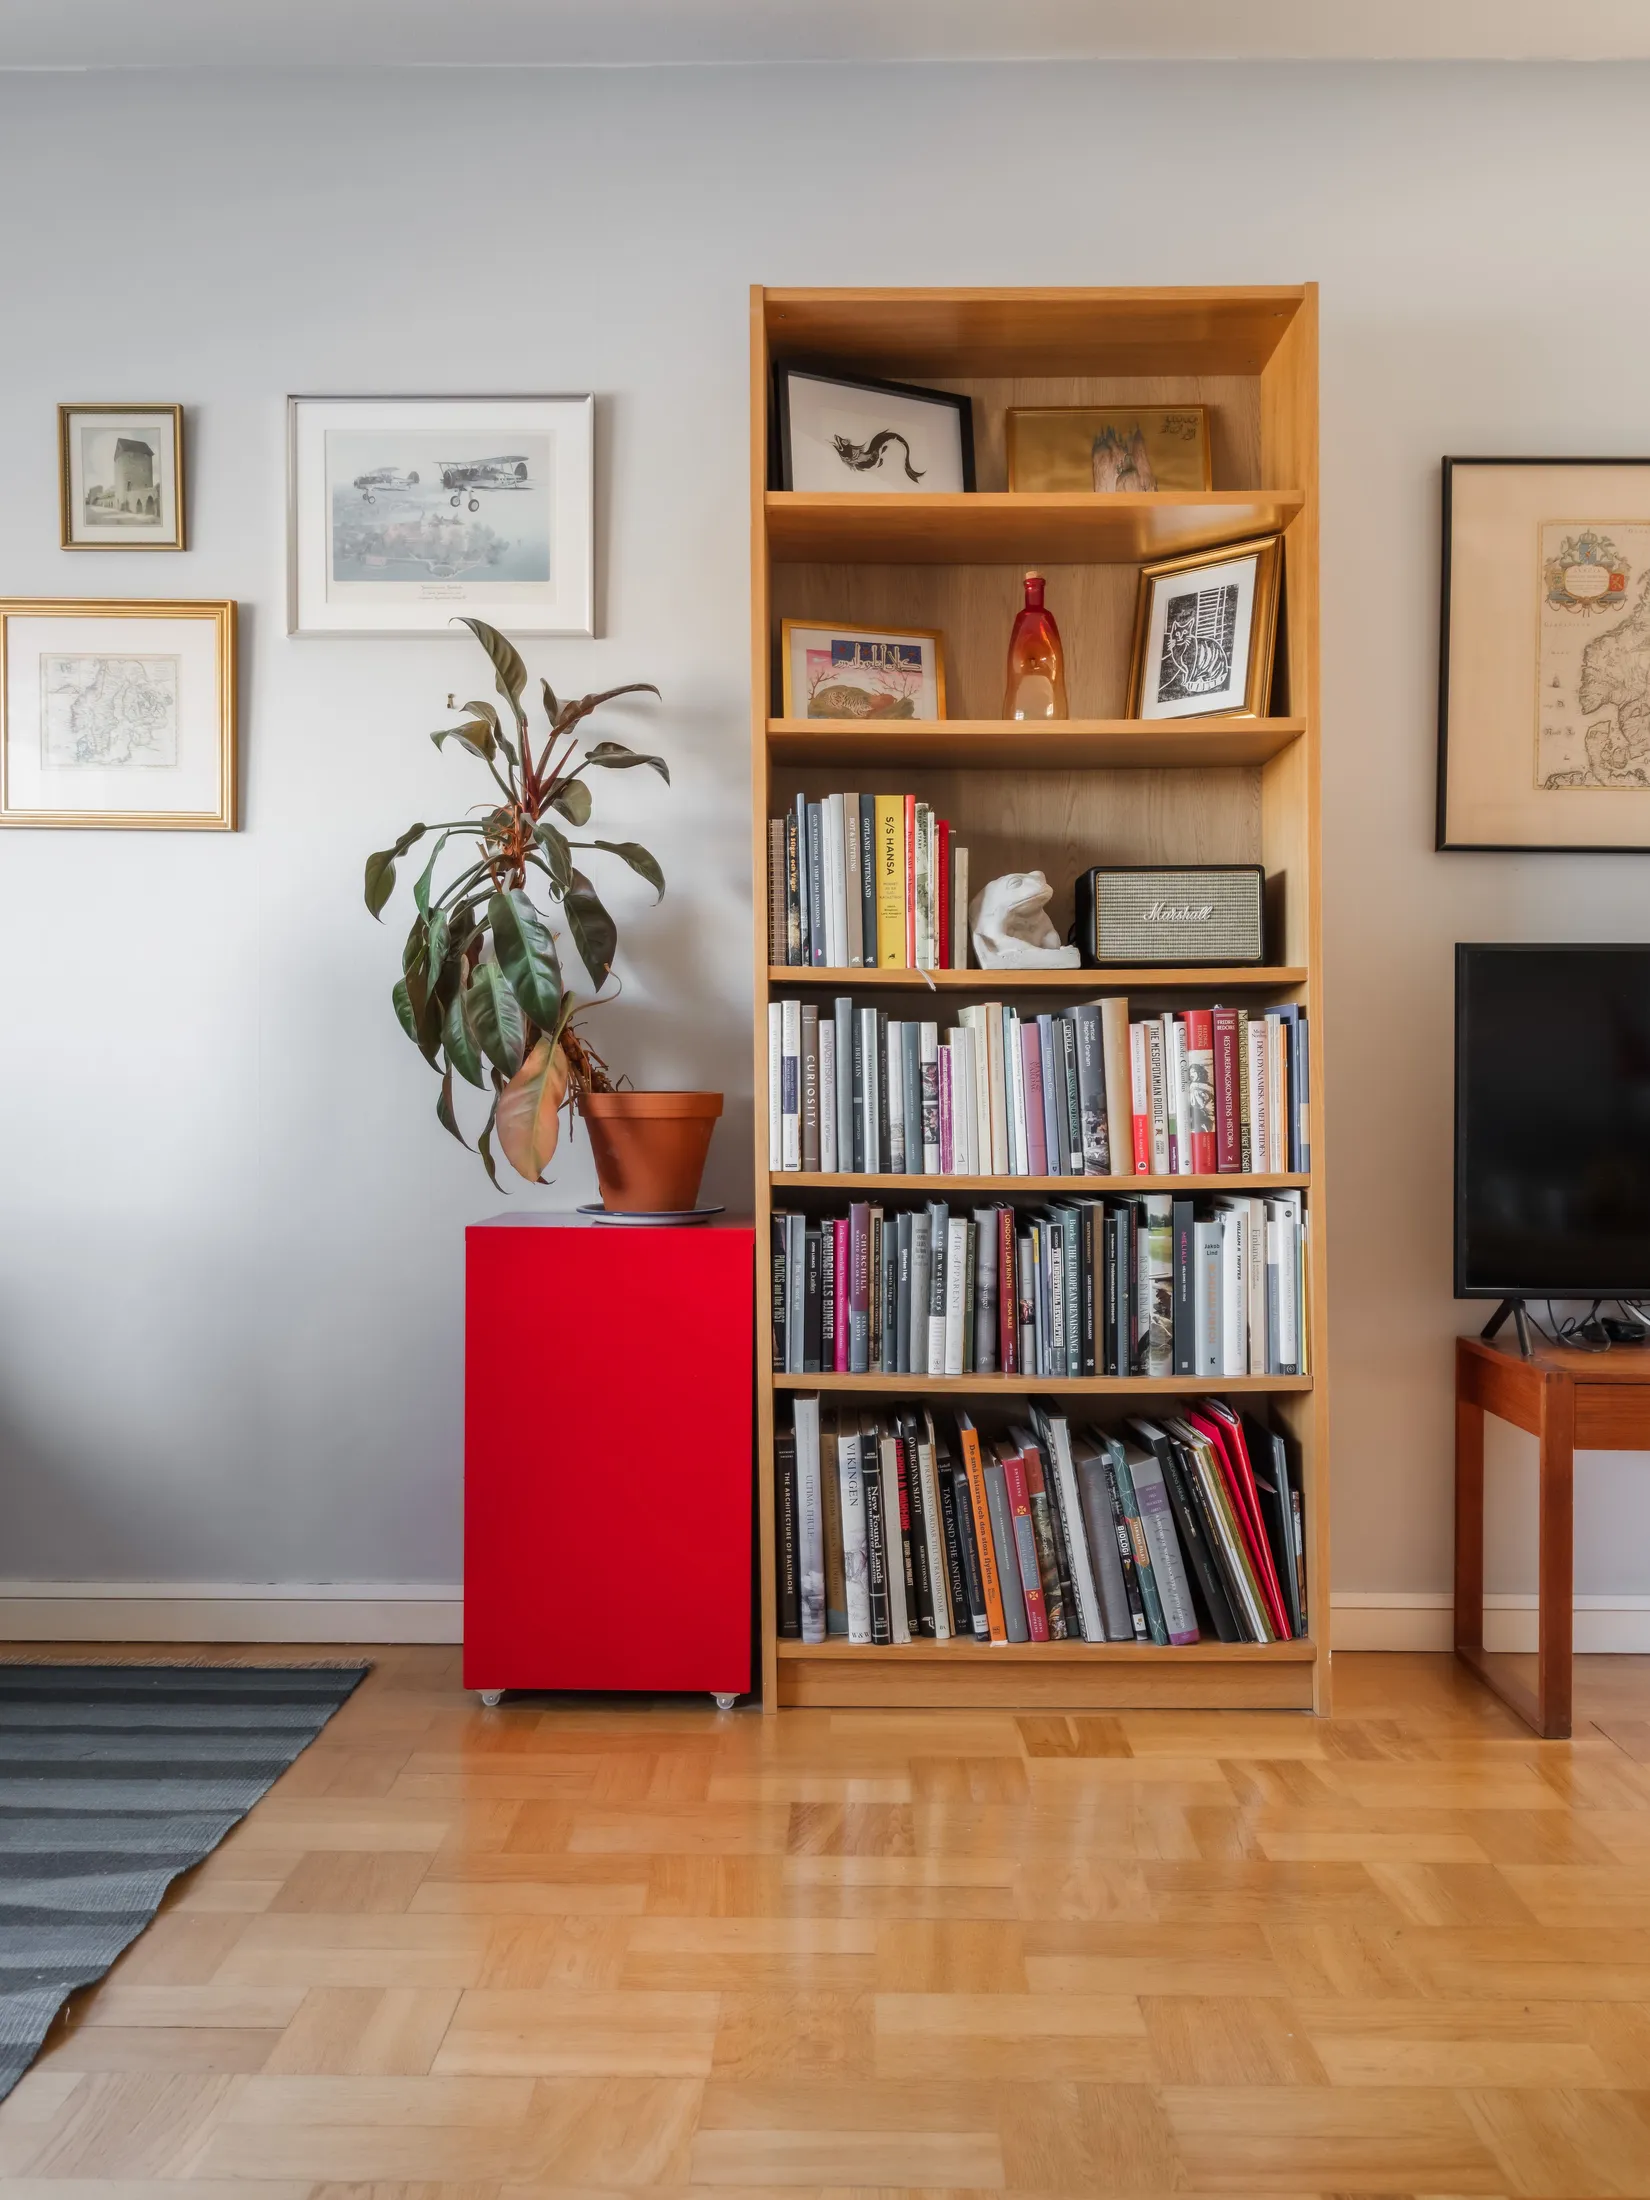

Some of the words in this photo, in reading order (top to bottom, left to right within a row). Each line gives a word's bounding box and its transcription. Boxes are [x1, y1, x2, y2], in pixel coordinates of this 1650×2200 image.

[885, 817, 894, 834] S/S
[886, 838, 894, 875] HANSA
[1143, 901, 1214, 921] Marshall
[1065, 1025, 1073, 1053] CIPOLLA
[1150, 1027, 1159, 1040] THE
[1240, 1012, 1248, 1058] Medeltidens
[824, 1041, 833, 1085] NAZISTISKA
[1151, 1043, 1161, 1096] MESOPOTAMIAN
[1224, 1036, 1233, 1117] RESTAURERINGSKONSTENS
[1240, 1059, 1249, 1094] allmänna
[807, 1055, 815, 1127] CURIOSITY
[1153, 1098, 1163, 1124] RIDDLE
[1241, 1095, 1250, 1122] historia
[1242, 1126, 1250, 1147] Jerker
[1243, 1149, 1251, 1172] Rosén
[953, 1230, 961, 1250] AIR
[1004, 1214, 1012, 1250] LONDON'S
[1252, 1229, 1261, 1263] Finland
[822, 1235, 833, 1296] CHURCHILLS
[1052, 1248, 1060, 1262] THE
[1068, 1245, 1076, 1260] THE
[774, 1255, 785, 1282] POLITICS
[953, 1255, 961, 1310] APPARENT
[1069, 1262, 1077, 1302] EUROPEAN
[774, 1285, 784, 1294] and
[1053, 1264, 1061, 1303] INDUSTRIAL
[774, 1296, 784, 1305] the
[1139, 1293, 1149, 1324] FINLAND
[774, 1307, 784, 1323] PAST
[823, 1300, 833, 1339] BUNKER
[1054, 1305, 1062, 1346] REVOLUTION
[1069, 1304, 1078, 1353] RENAISSANCE
[969, 1444, 976, 1456] De
[847, 1443, 858, 1507] VIKINGEN
[908, 1436, 918, 1486] ÖVERGIVNA
[913, 1487, 921, 1514] SLOTT
[924, 1464, 933, 1484] FRÅN
[970, 1457, 978, 1473] små
[1166, 1456, 1181, 1484] BARONENS
[806, 1475, 814, 1507] ULTIMA
[972, 1475, 982, 1505] båtarna
[1014, 1468, 1022, 1497] ENTERLINE
[871, 1486, 879, 1512] New
[898, 1489, 910, 1531] WARFARE
[926, 1486, 937, 1537] PRÄSTGÅRDAR
[943, 1487, 952, 1515] TASTE
[976, 1506, 984, 1520] och
[1036, 1498, 1045, 1521] Military
[806, 1509, 815, 1537] THULE
[873, 1515, 881, 1550] Found
[946, 1518, 956, 1537] AND
[978, 1522, 986, 1536] den
[1155, 1519, 1165, 1540] HISTORY
[786, 1543, 792, 1552] OF
[931, 1540, 939, 1555] TILL
[949, 1540, 958, 1558] THE
[979, 1537, 988, 1556] stora
[1038, 1523, 1049, 1555] Landscapes
[1117, 1526, 1128, 1555] BIOLOGI
[921, 1565, 929, 1592] CONNOLLY
[932, 1557, 944, 1613] STRANDBODAR
[952, 1561, 963, 1602] ANTIQUE
[981, 1558, 993, 1584] flykten
